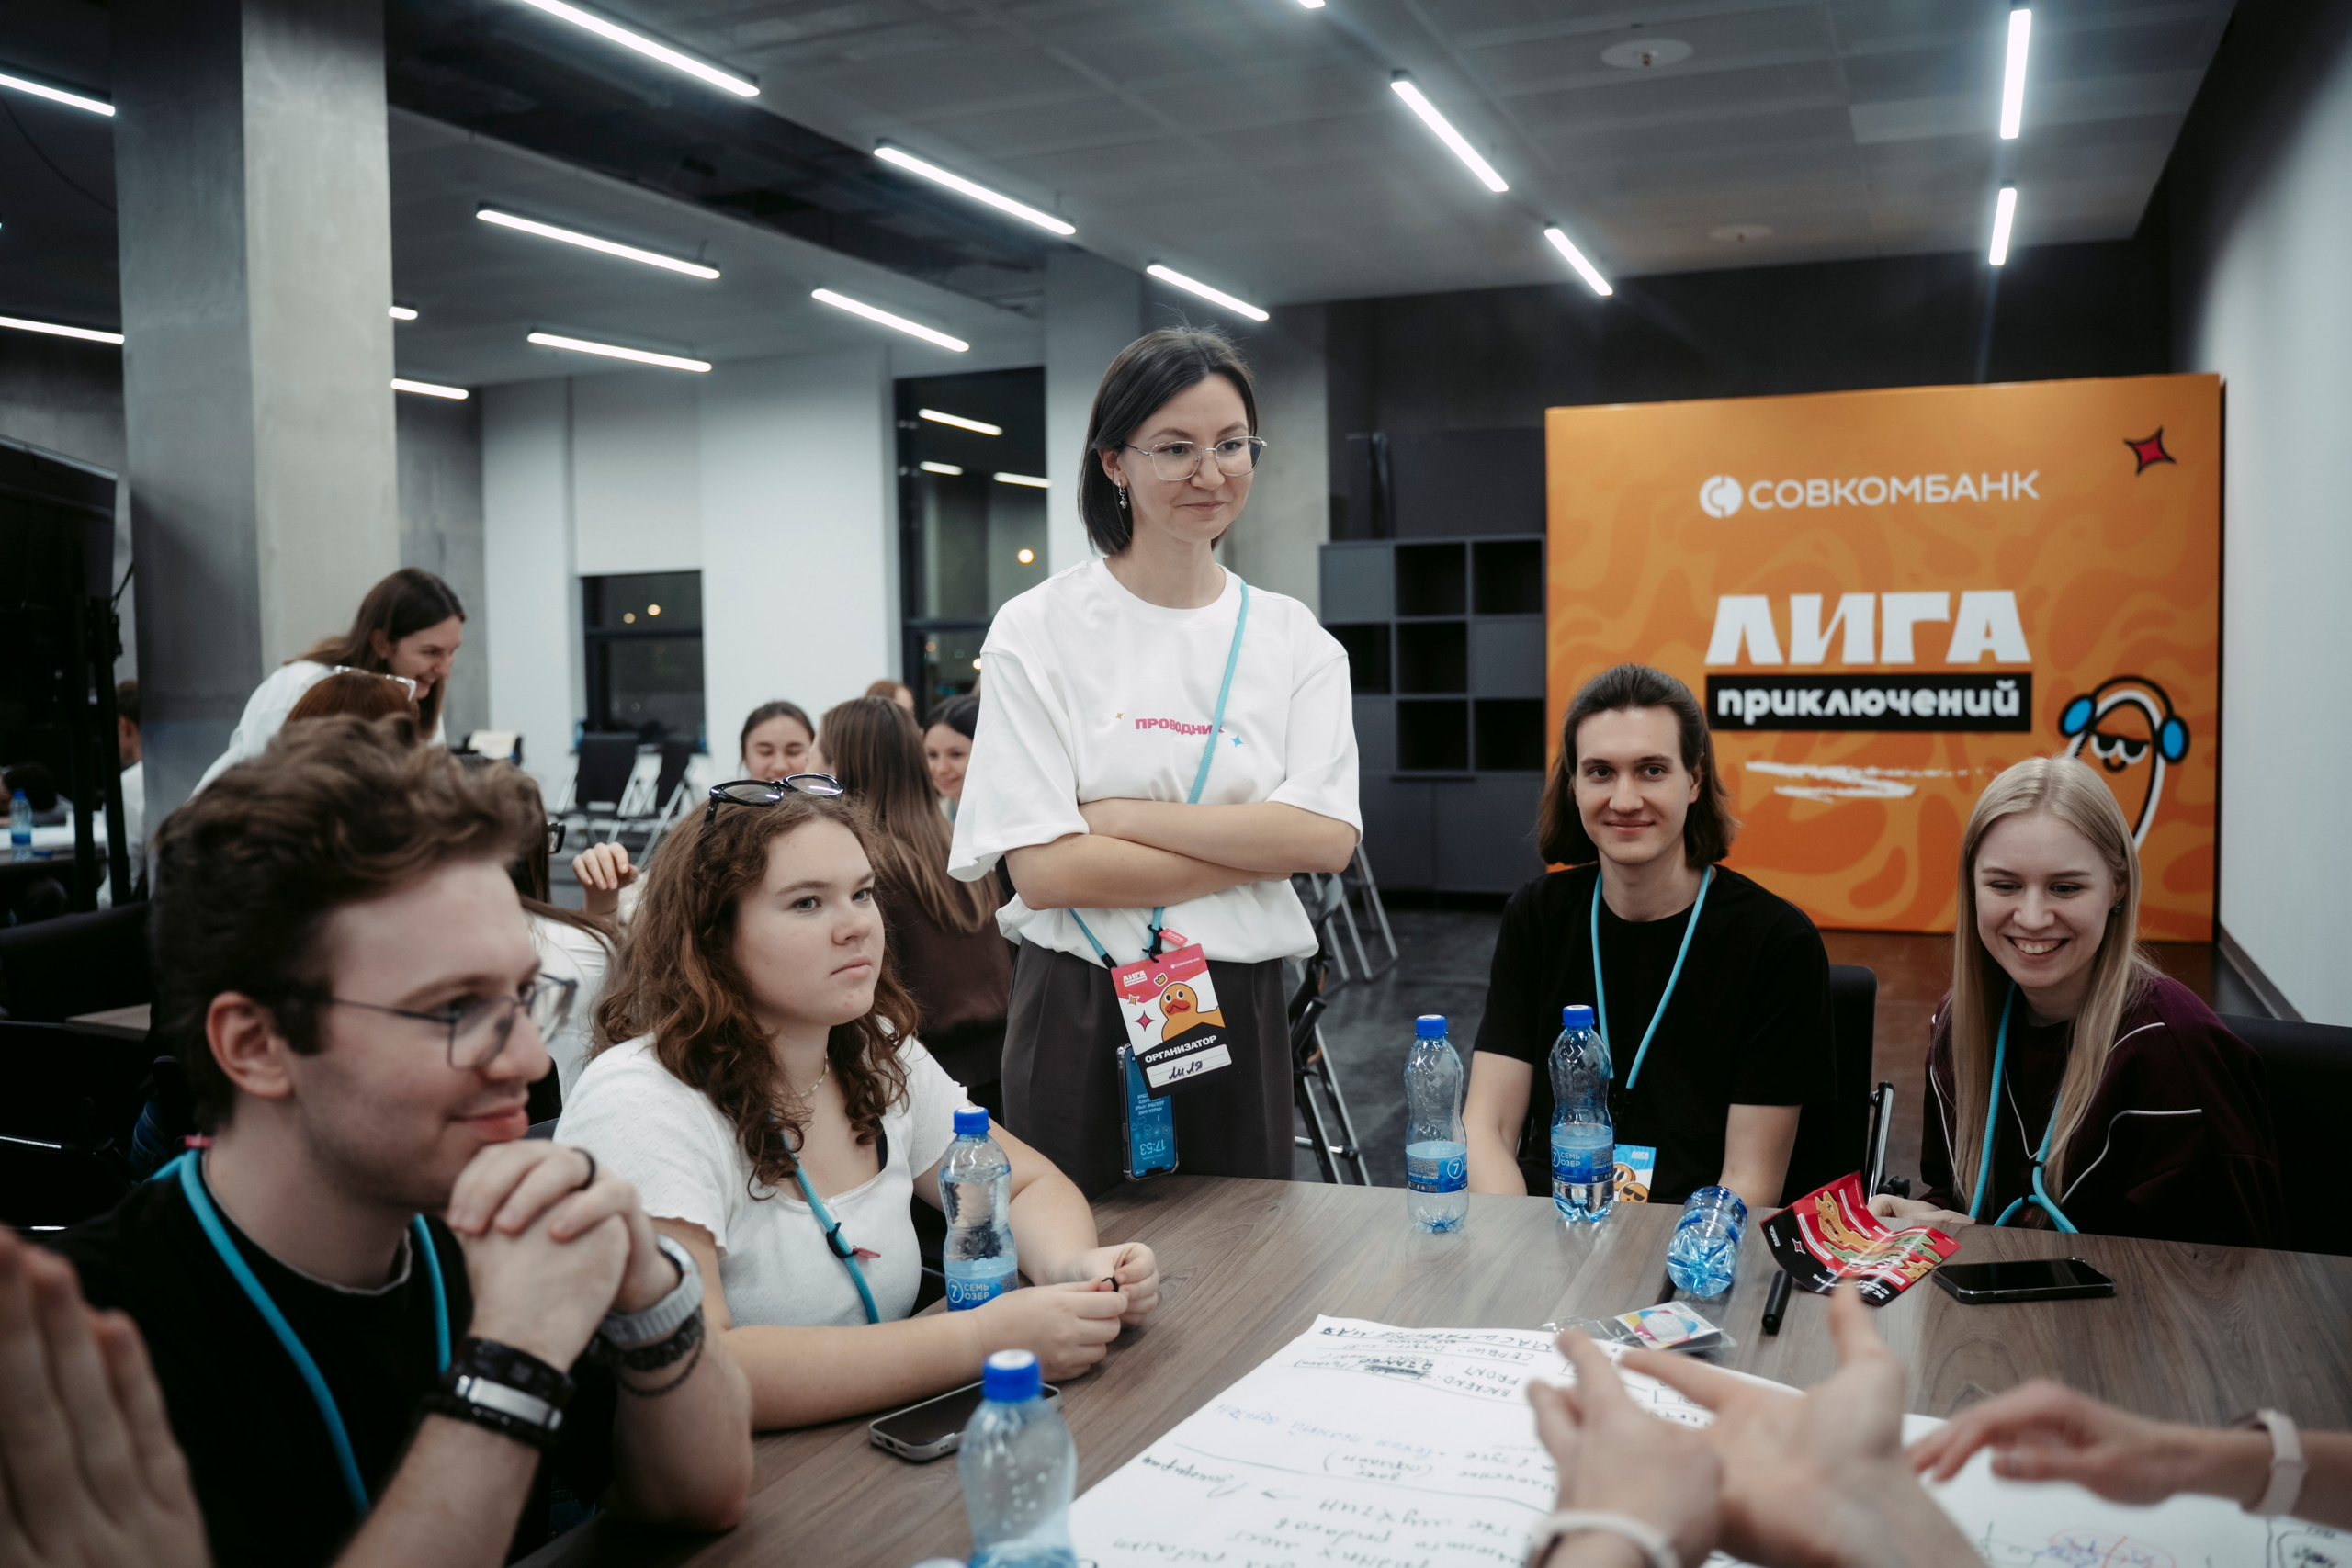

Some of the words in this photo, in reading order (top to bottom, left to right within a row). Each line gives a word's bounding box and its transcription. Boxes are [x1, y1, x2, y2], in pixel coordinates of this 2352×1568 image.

[1748, 470, 2040, 509] СОВКОМБАНК
[1704, 590, 2032, 665] ЛИГА
[1717, 680, 2020, 725] приключений
[1123, 970, 1146, 982] ЛИГА
[1145, 1035, 1217, 1063] ОРГАНИЗАТОР
[1139, 1139, 1166, 1156] 17:53
[1560, 1151, 1581, 1160] СЕМЬ
[1453, 1162, 1460, 1175] 7
[1560, 1159, 1581, 1168] ОЗЕР
[951, 1284, 958, 1298] 7
[964, 1283, 989, 1292] СЕМЬ
[964, 1292, 990, 1300] ОЗЕР
